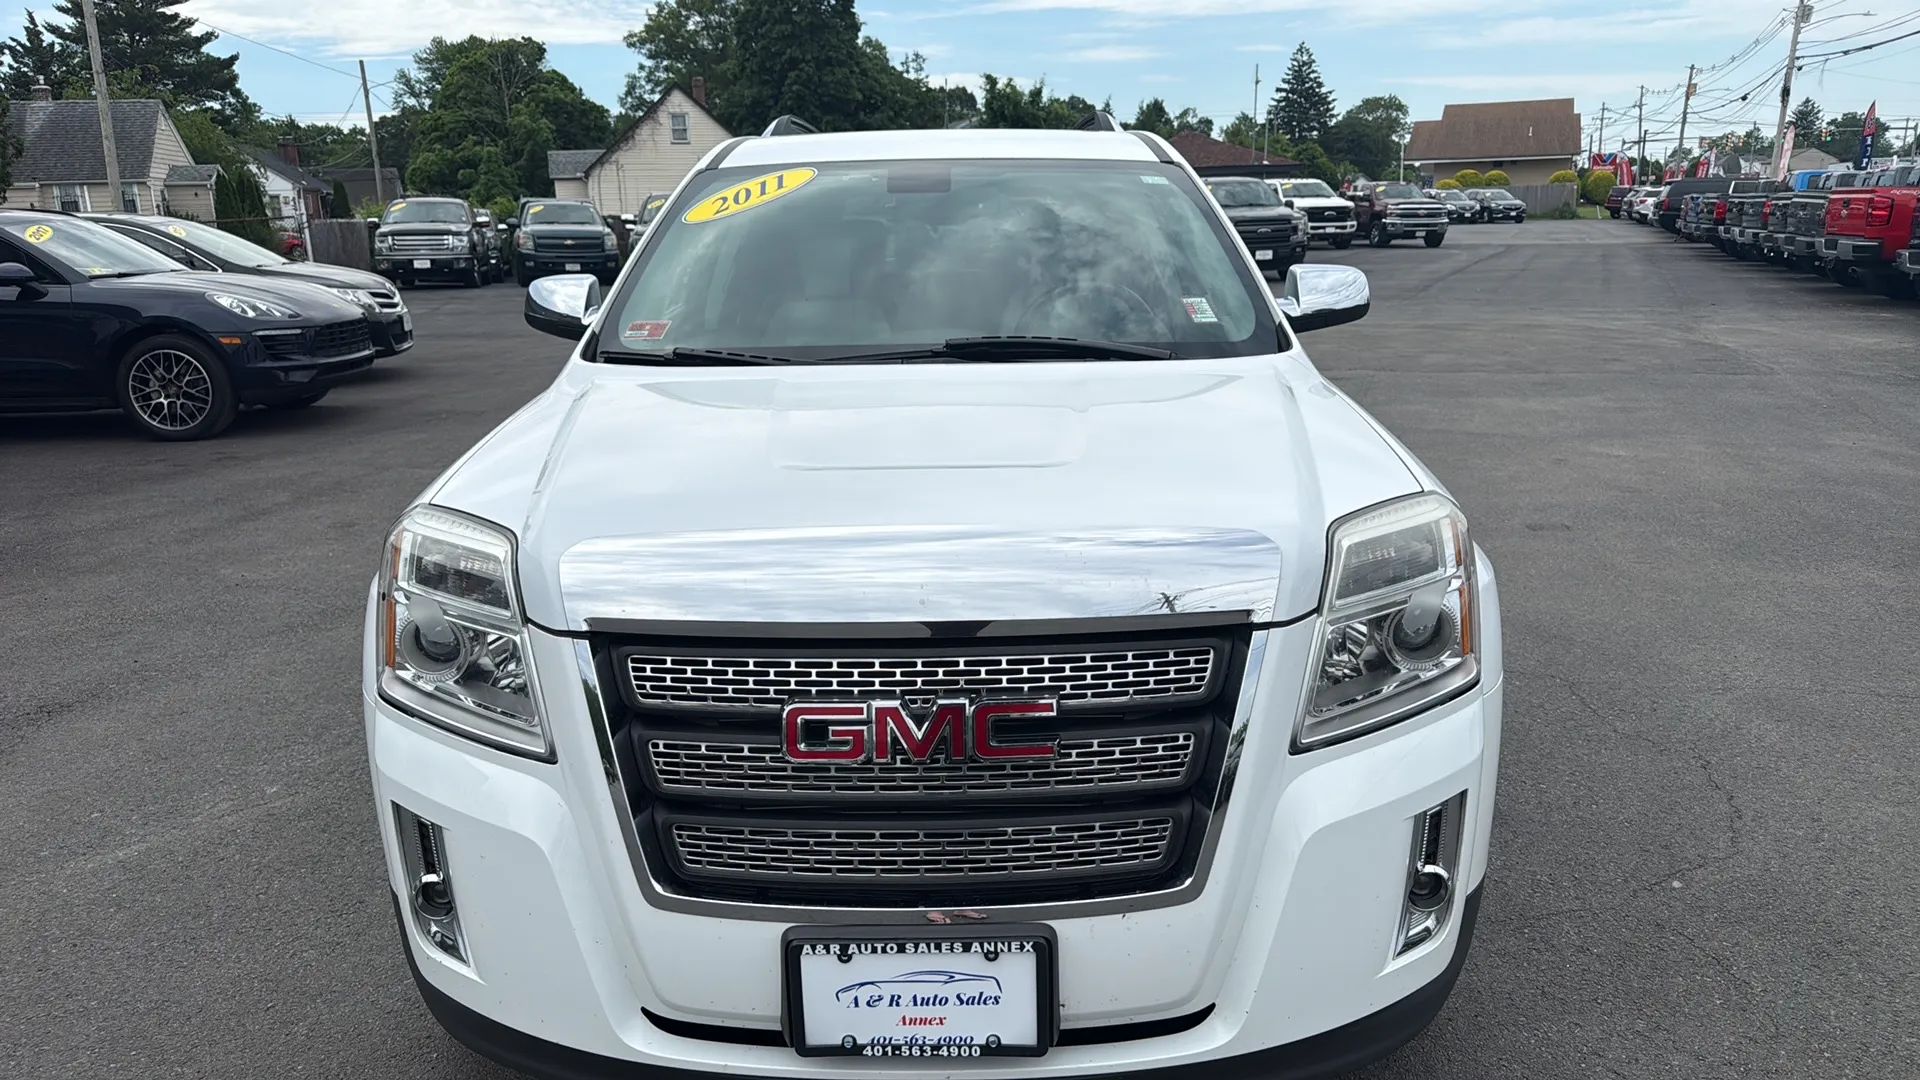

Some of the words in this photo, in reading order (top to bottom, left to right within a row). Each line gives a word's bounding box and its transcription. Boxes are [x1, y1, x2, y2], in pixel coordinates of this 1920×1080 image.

[712, 174, 787, 216] 2011
[783, 698, 1059, 763] GMC
[801, 944, 840, 956] A&R
[849, 943, 898, 955] AUTO
[905, 942, 963, 954] SALES
[970, 941, 1035, 953] ANNEX
[847, 994, 860, 1009] A
[866, 994, 884, 1008] &
[888, 994, 902, 1008] R
[906, 993, 949, 1008] Auto
[953, 991, 1001, 1007] Sales
[896, 1014, 947, 1027] Annex
[862, 1045, 981, 1057] 401-563-4900
